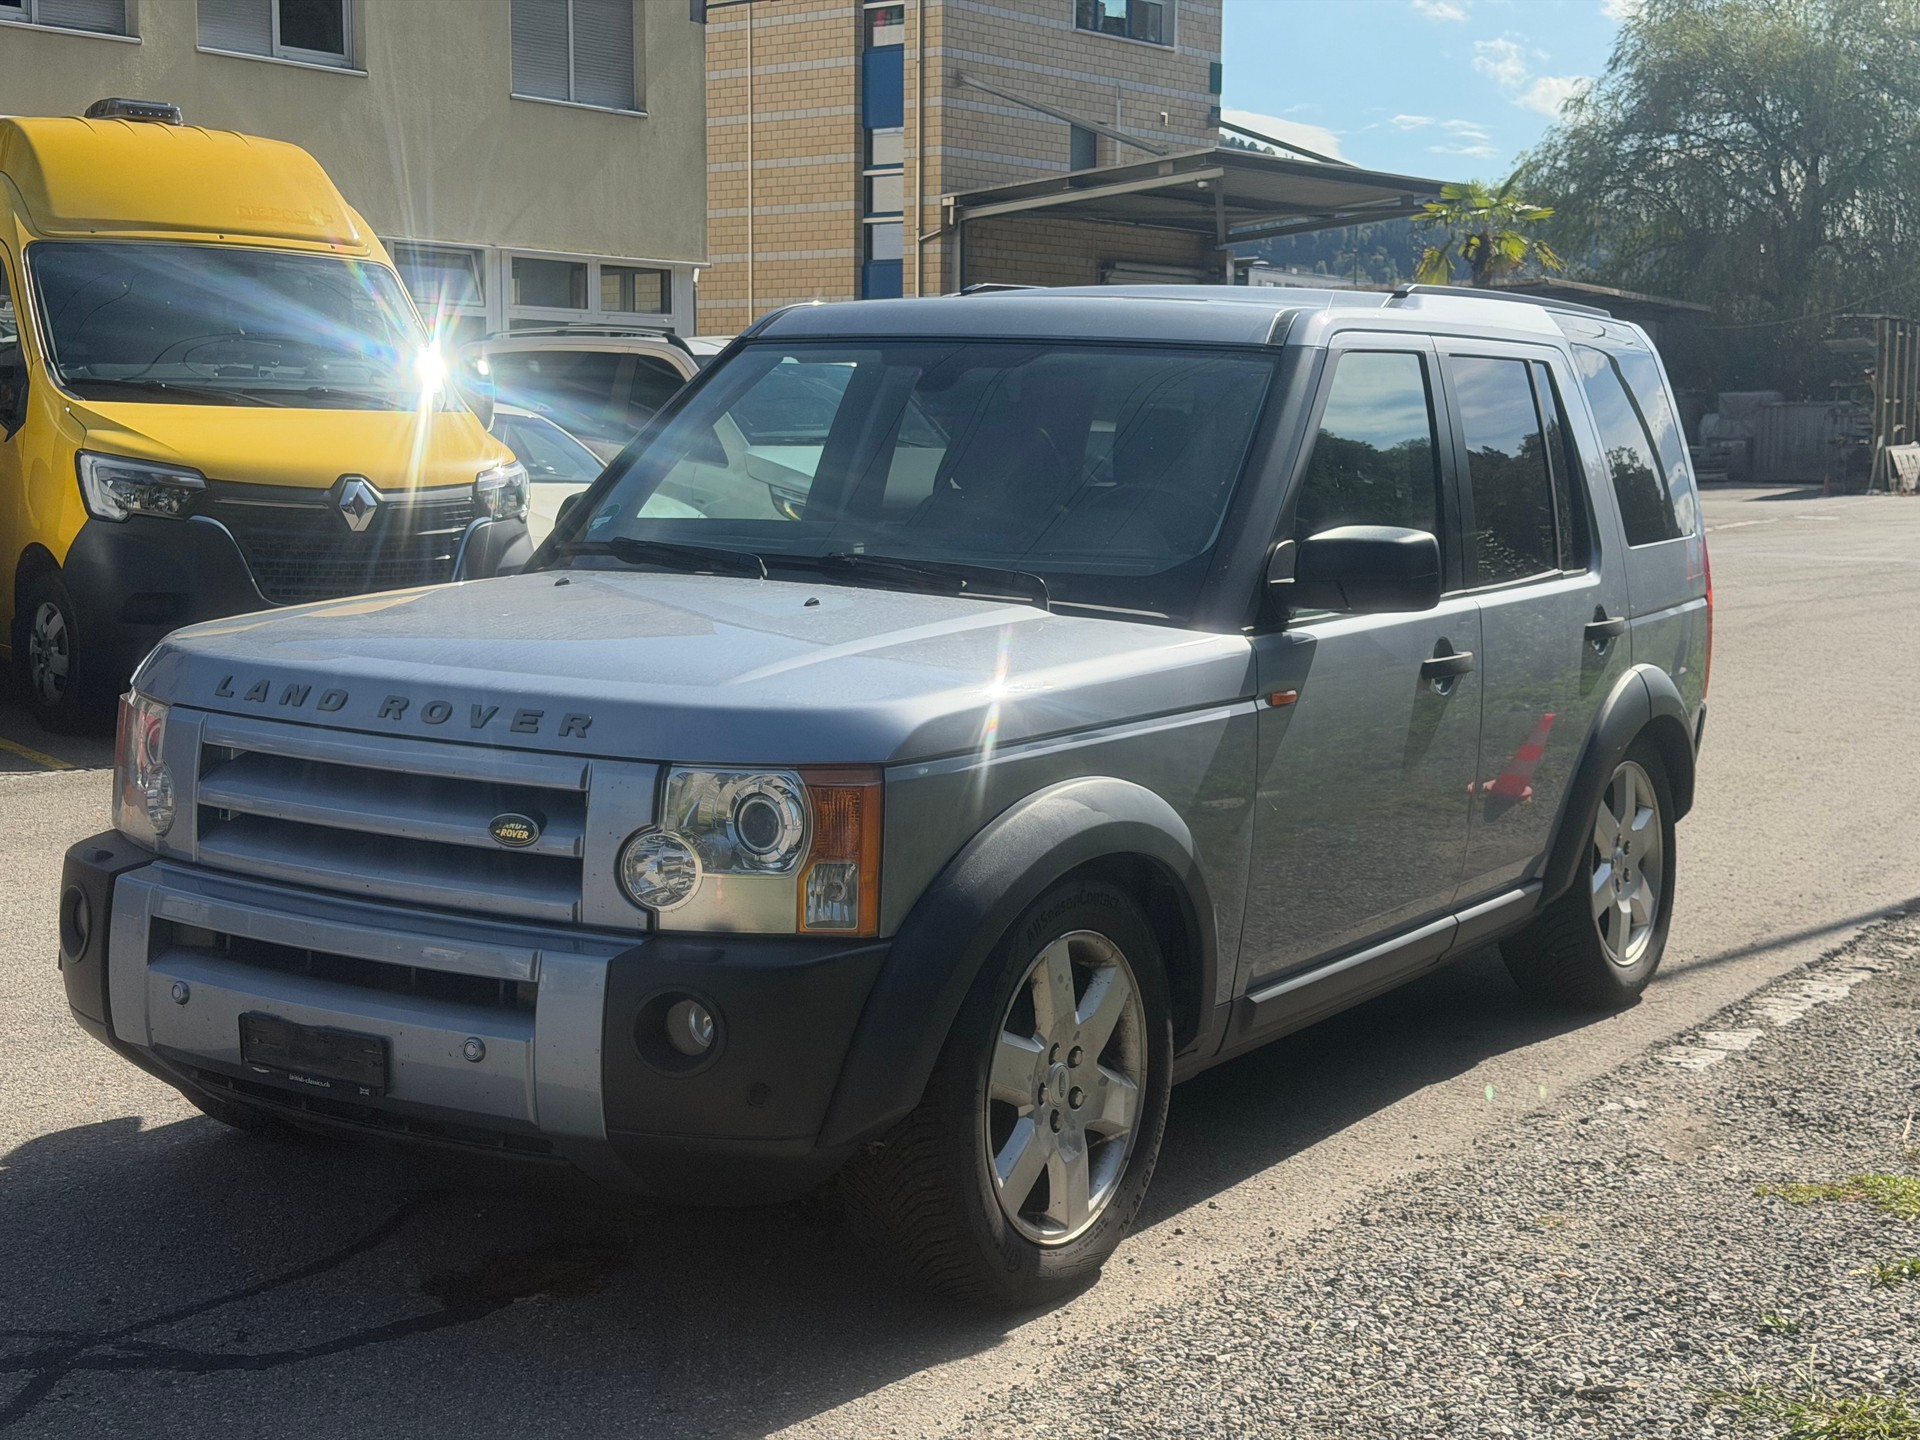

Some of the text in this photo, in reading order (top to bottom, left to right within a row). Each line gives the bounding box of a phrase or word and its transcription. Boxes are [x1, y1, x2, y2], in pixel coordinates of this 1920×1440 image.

[214, 675, 592, 738] LAND ROVER
[502, 829, 528, 839] ROVER
[1025, 889, 1120, 942] AllSeasonContact
